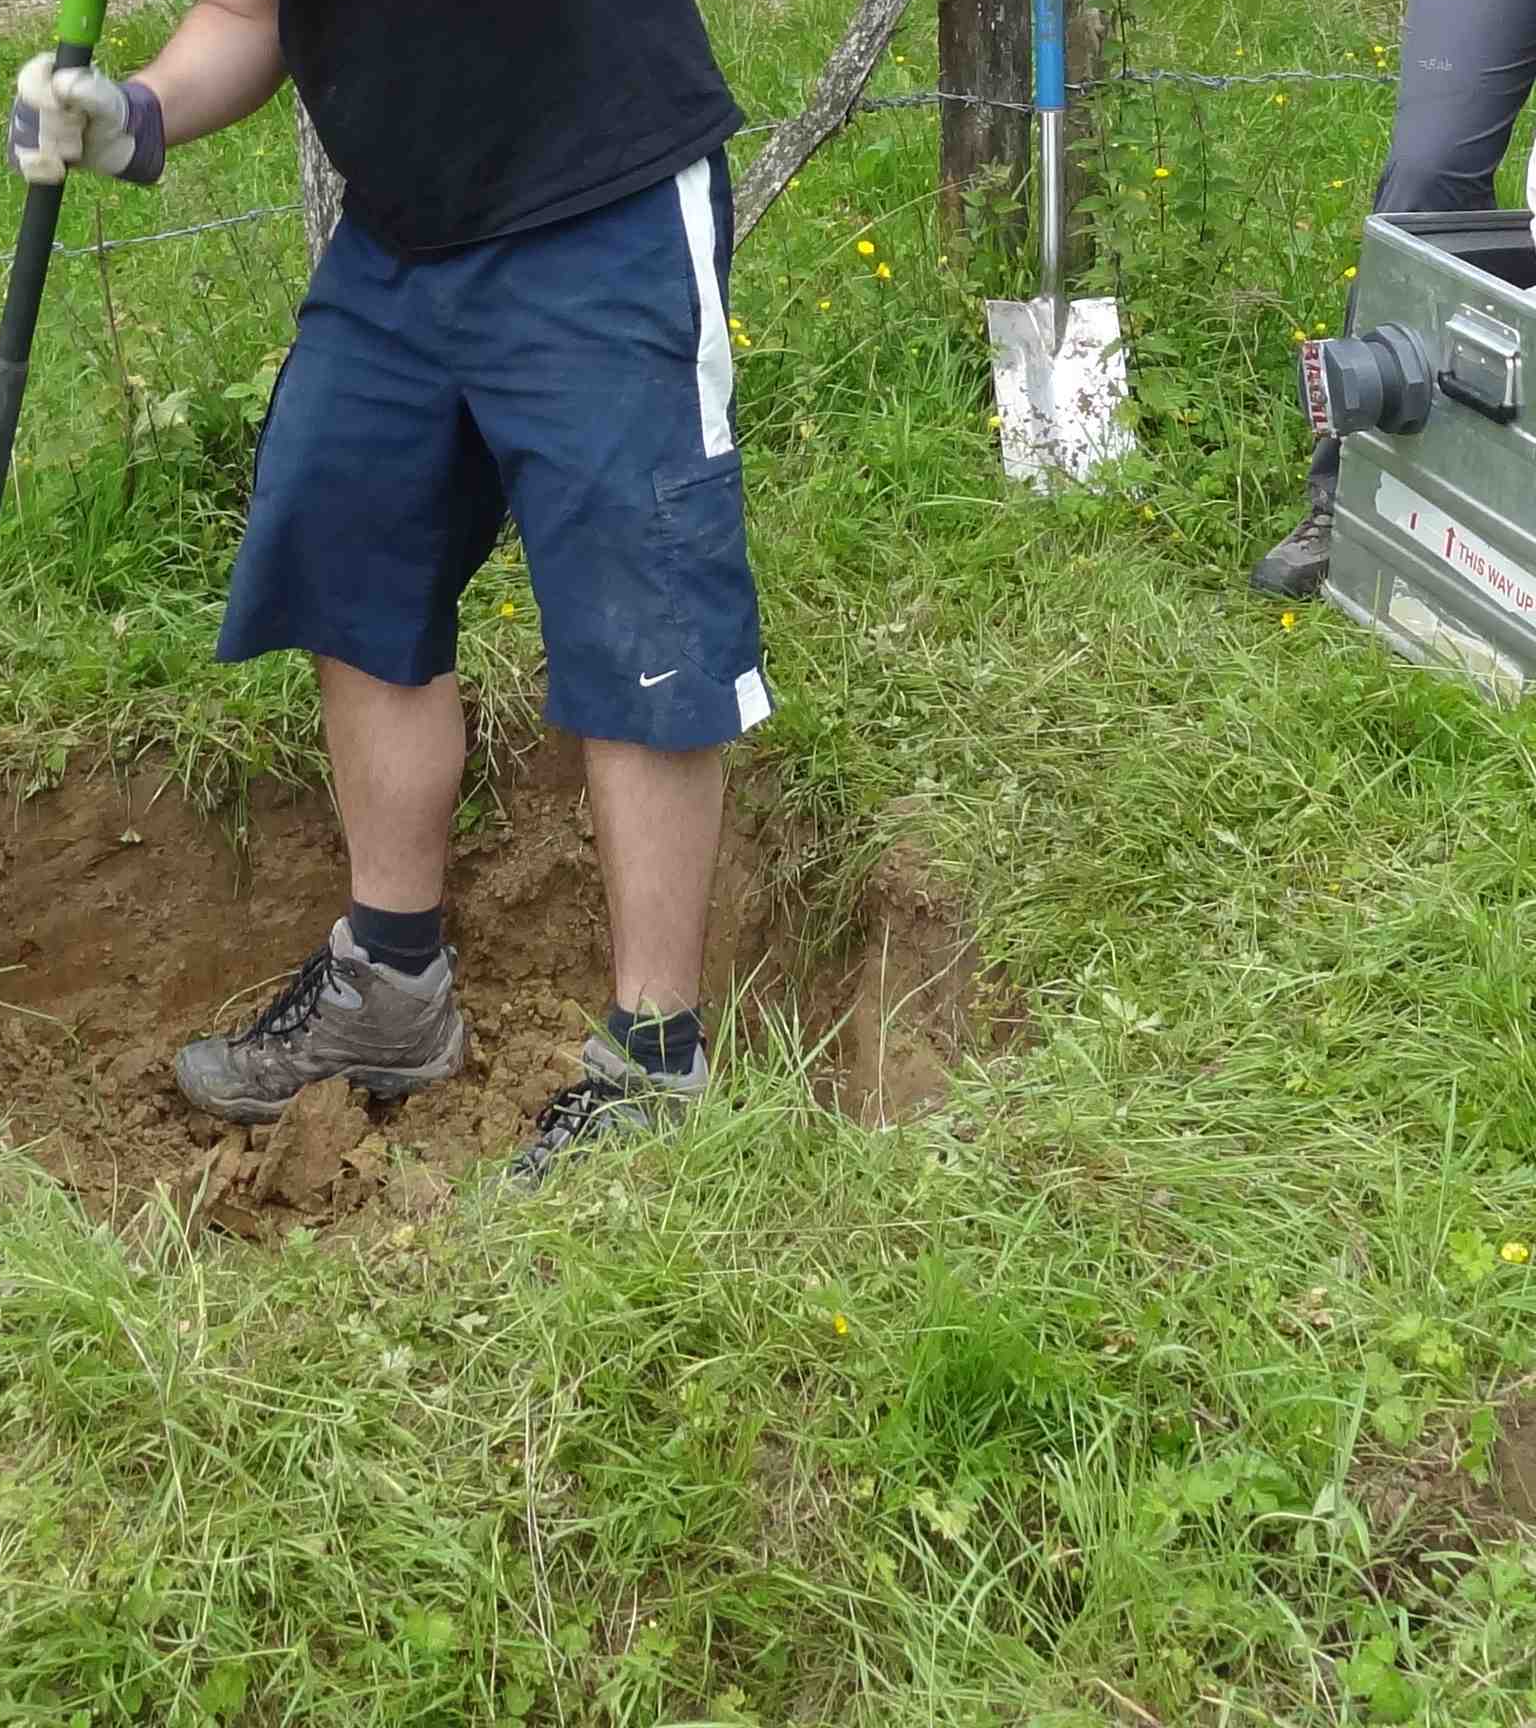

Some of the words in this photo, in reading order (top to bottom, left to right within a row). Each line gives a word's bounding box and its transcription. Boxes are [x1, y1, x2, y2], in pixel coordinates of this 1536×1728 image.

[1459, 542, 1484, 575] THIS
[1488, 566, 1515, 598] WAY
[1516, 588, 1534, 611] UP
